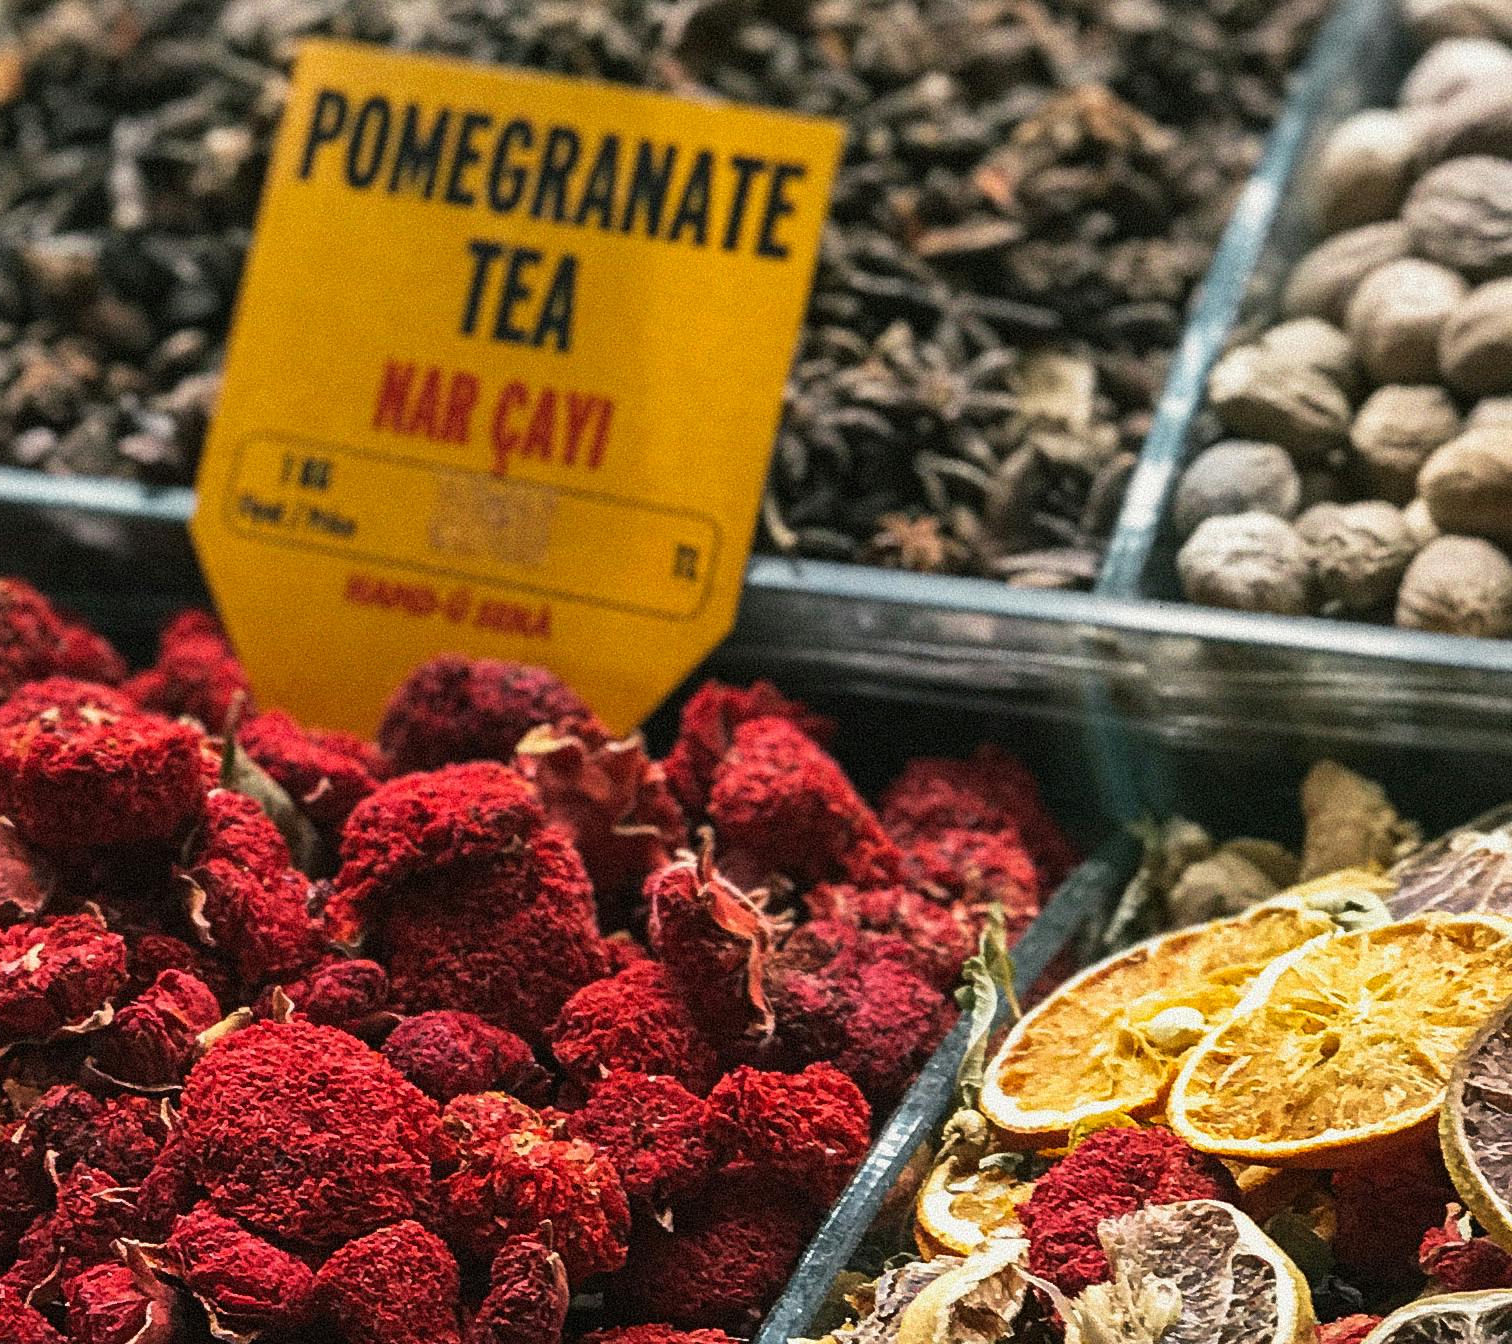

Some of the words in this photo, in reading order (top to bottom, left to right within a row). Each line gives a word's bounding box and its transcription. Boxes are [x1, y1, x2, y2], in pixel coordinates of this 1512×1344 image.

[296, 88, 808, 262] POMEGRANATE
[458, 237, 581, 353] TEA
[372, 359, 481, 446] NAR
[491, 378, 616, 478] ÇAYI
